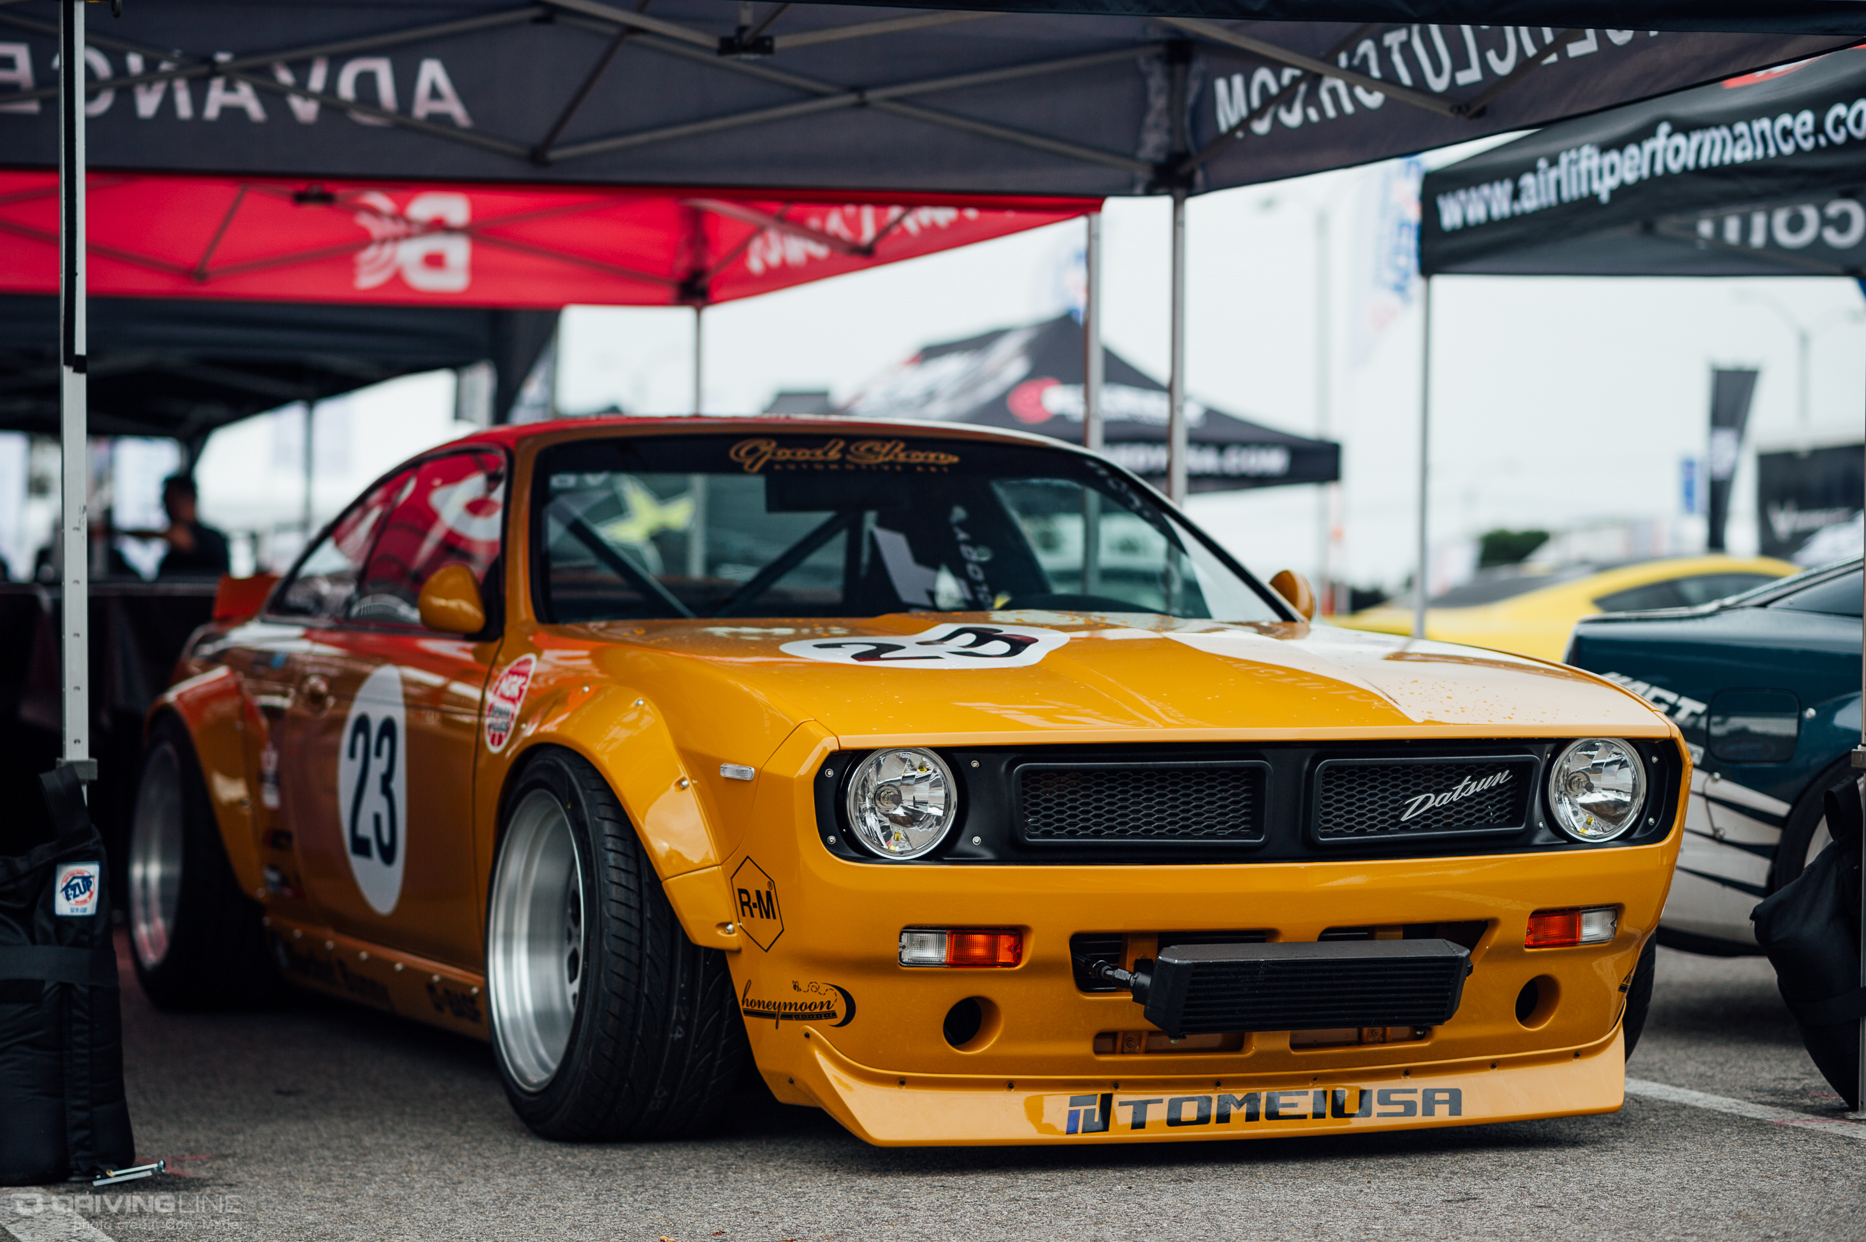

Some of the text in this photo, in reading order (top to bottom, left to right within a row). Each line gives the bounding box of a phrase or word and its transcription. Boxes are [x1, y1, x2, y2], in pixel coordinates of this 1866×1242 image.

[730, 438, 845, 473] Good
[812, 627, 1039, 662] 23
[348, 713, 398, 867] 23
[1400, 769, 1513, 822] Datsun
[741, 979, 834, 1030] honeymoon
